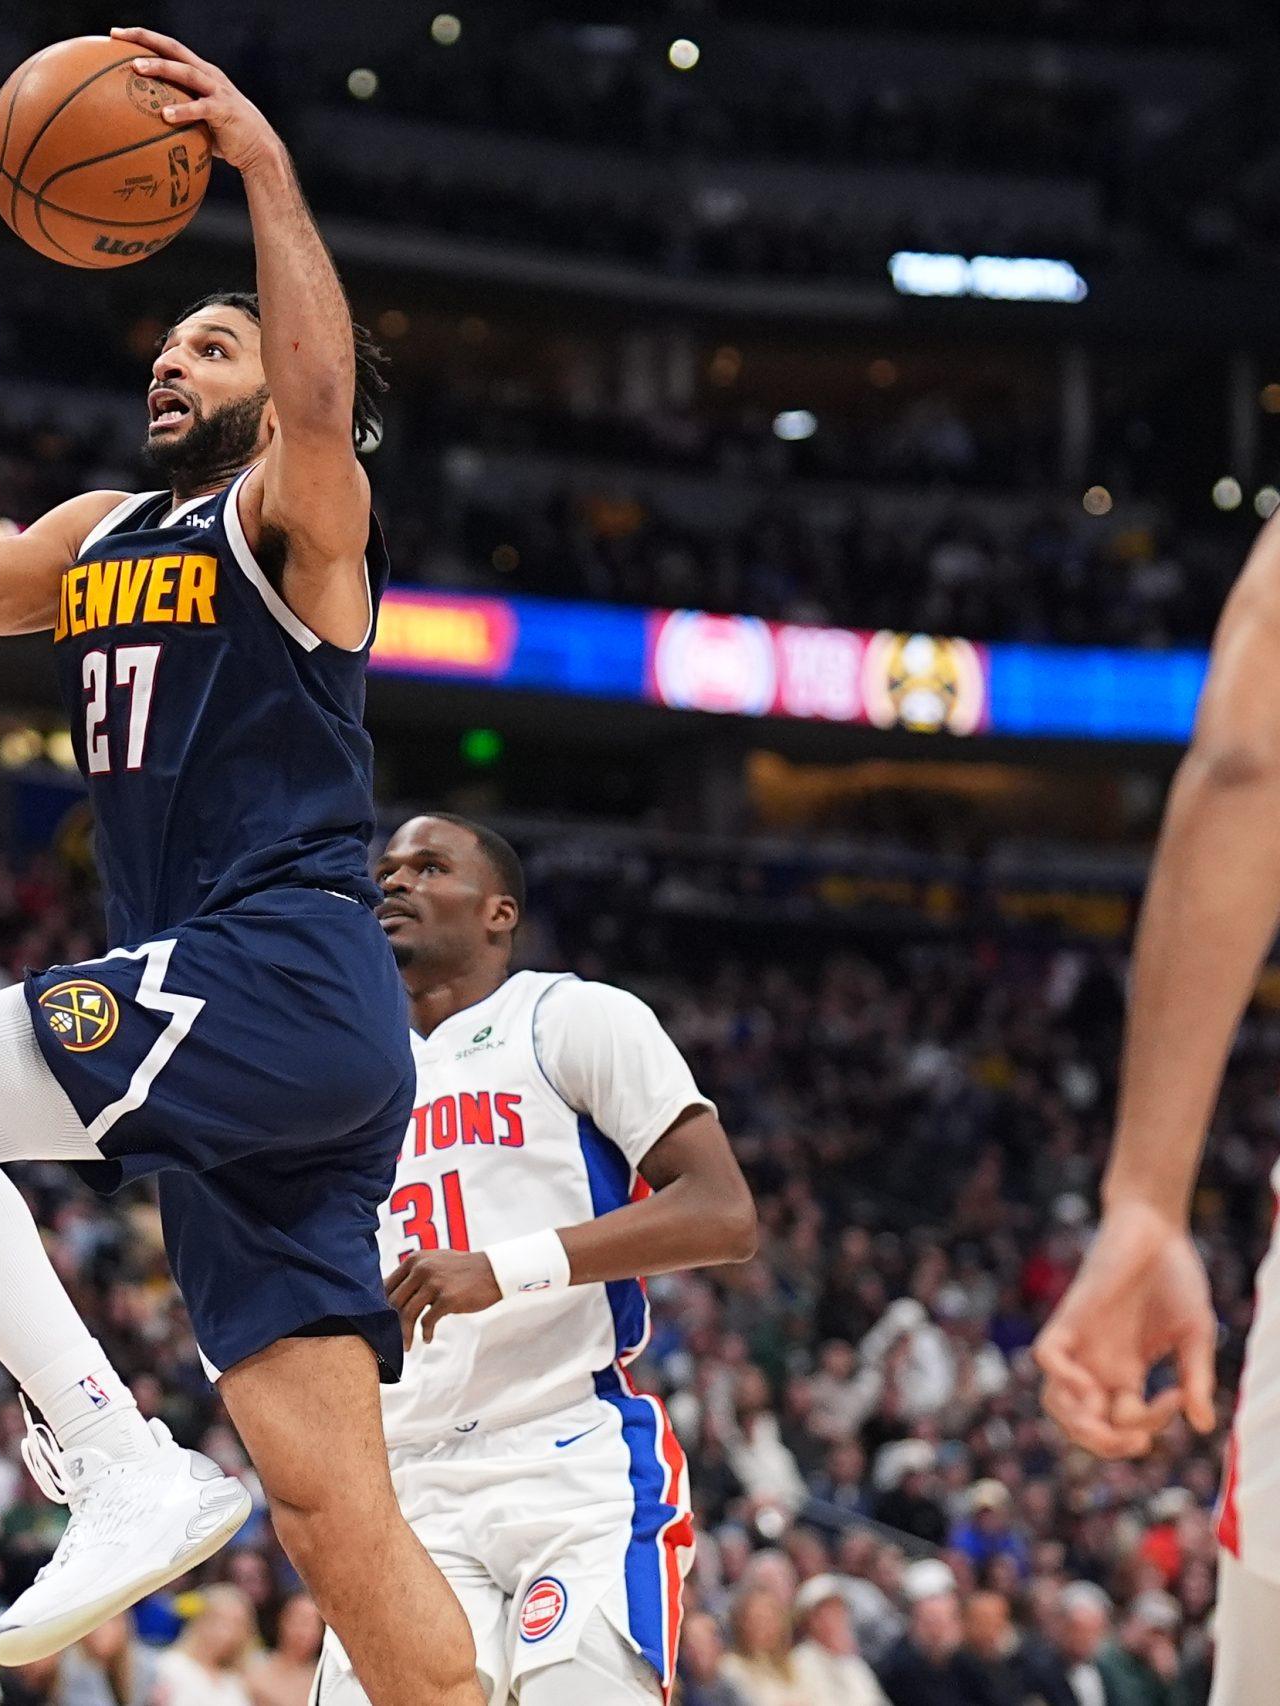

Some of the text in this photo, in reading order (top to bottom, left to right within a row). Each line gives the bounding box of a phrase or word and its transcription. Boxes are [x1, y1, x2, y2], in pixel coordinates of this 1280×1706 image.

[81, 642, 163, 776] 27
[397, 1091, 524, 1161] TONS
[389, 1169, 471, 1264] 31
